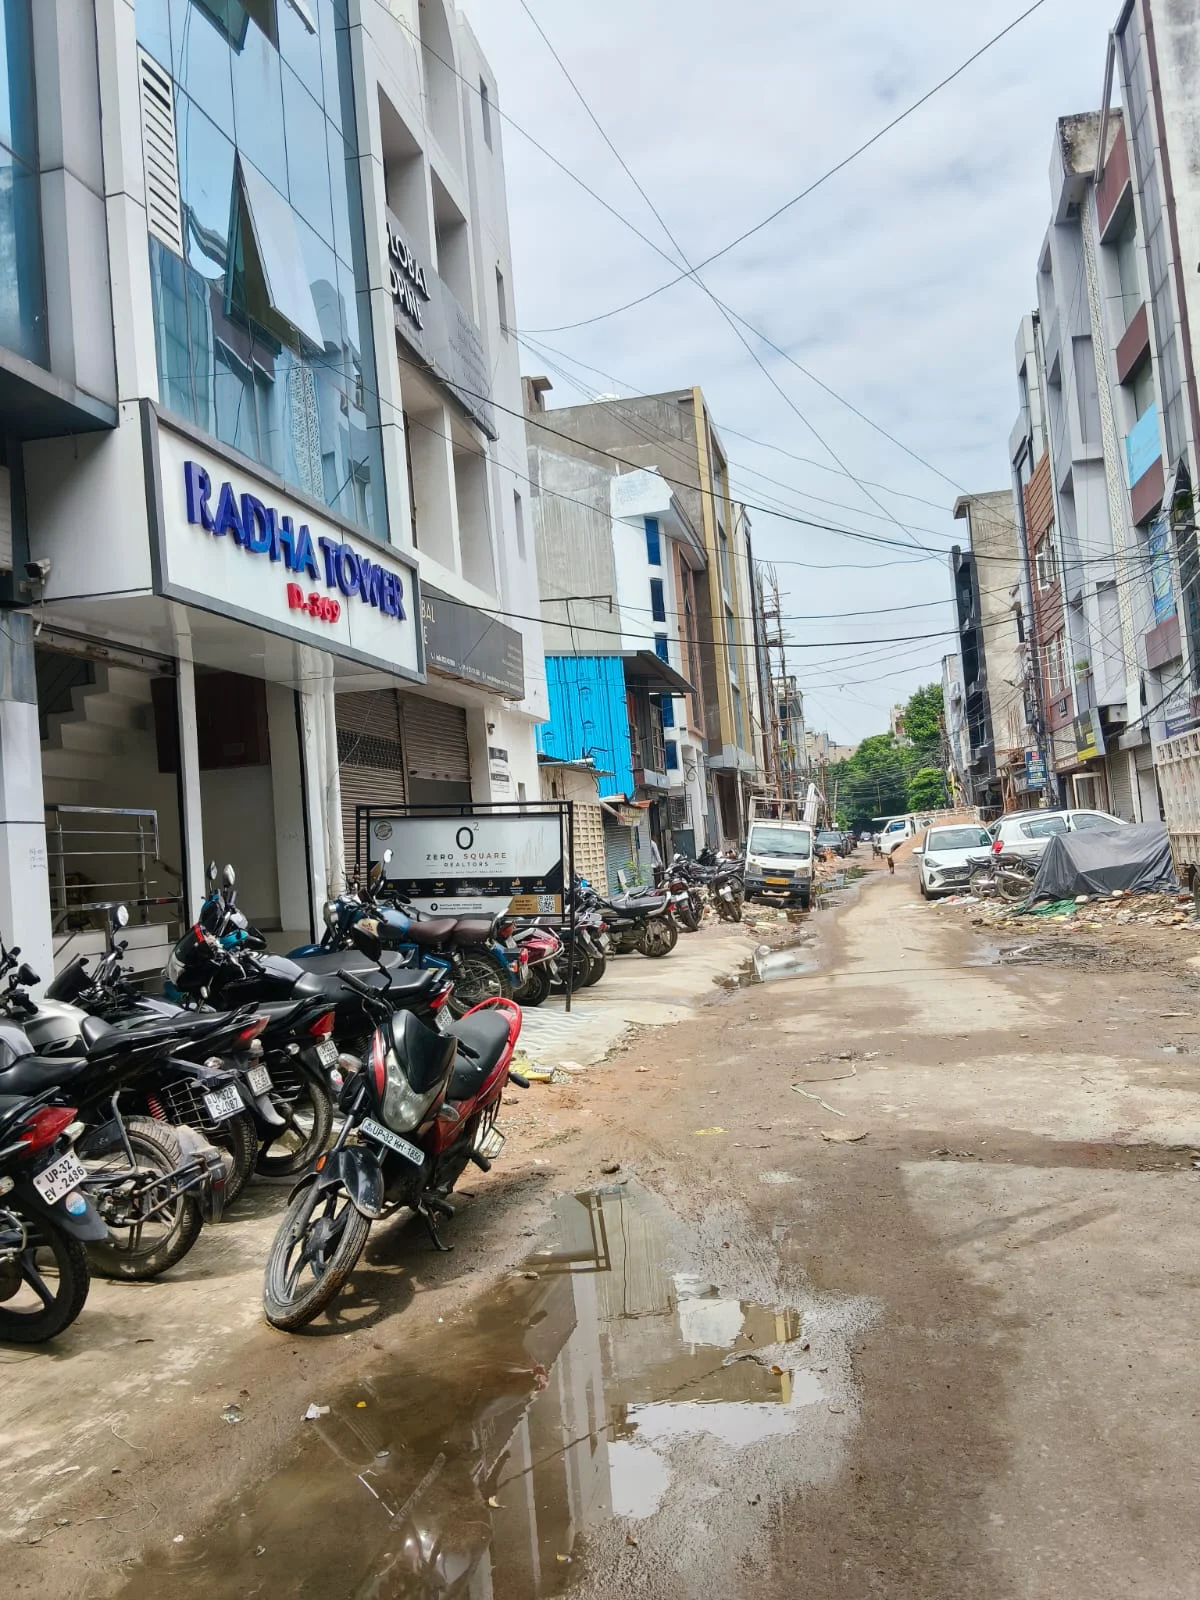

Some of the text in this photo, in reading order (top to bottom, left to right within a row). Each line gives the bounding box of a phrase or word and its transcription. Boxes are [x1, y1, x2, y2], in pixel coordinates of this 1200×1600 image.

[383, 221, 431, 300] LOBAL
[184, 460, 407, 621] RADHA TOWER
[426, 852, 507, 861] ZERO SQUARE
